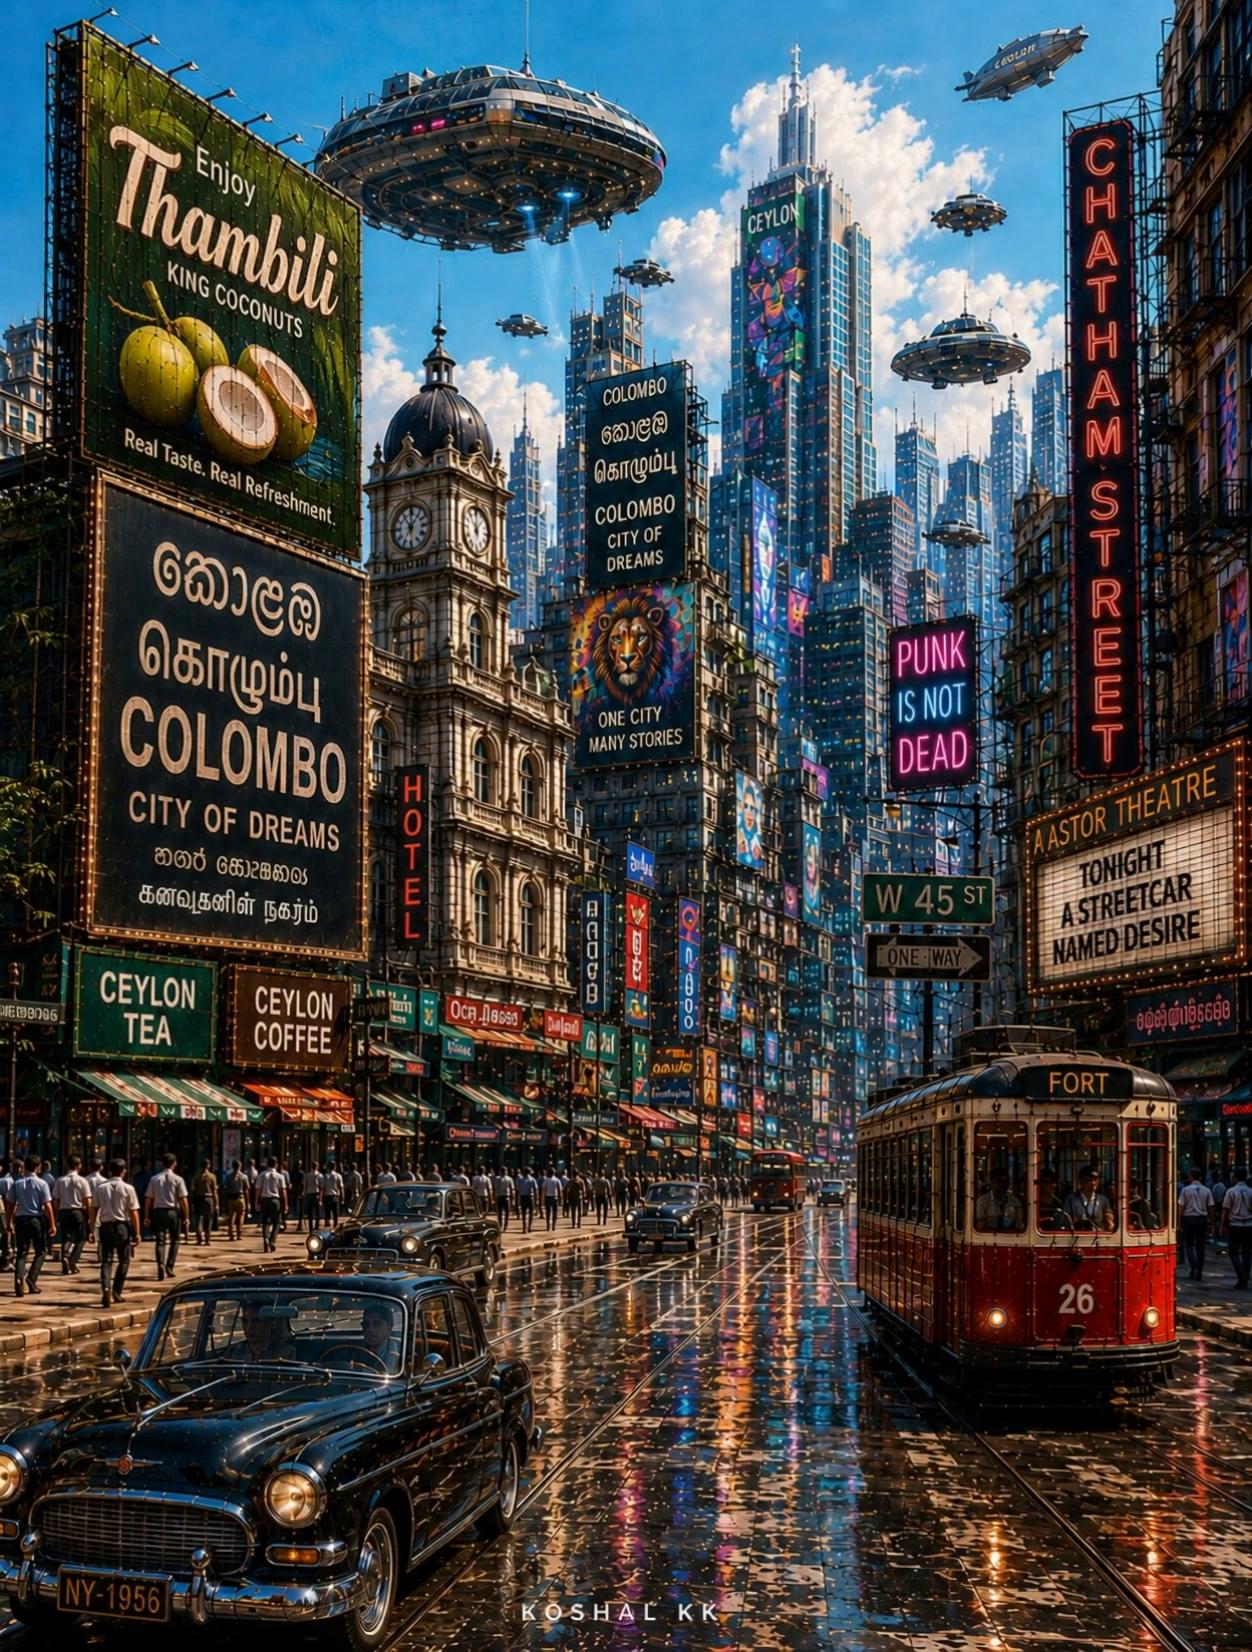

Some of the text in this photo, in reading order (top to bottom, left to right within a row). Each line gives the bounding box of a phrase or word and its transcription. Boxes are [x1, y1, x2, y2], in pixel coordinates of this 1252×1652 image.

[196, 147, 256, 207] Enjoy
[109, 125, 340, 316] Thambili
[748, 201, 799, 234] CEYLON
[168, 262, 304, 339] KING COCONUTS
[603, 377, 667, 407] COLOMBO
[1085, 138, 1123, 763] CHATHAM STREET
[124, 428, 336, 527] Real Taste. Real Refreshment.
[595, 494, 676, 526] COLOMBO
[607, 526, 663, 549] CITY OF
[607, 550, 664, 572] DREAMS
[897, 630, 966, 678] PUNK
[598, 706, 662, 728] ONE CITY
[898, 682, 966, 723] IS NOT
[120, 696, 347, 804] COLOMBO
[589, 728, 683, 753] MANY STORIES
[899, 731, 968, 774] DEAD
[128, 791, 340, 852] CITY OF DREAMS
[1047, 806, 1106, 850] ASTOR
[1115, 765, 1217, 826] THEATRE
[404, 774, 421, 939] HOTEL
[1079, 839, 1166, 888] TONIGHT
[875, 884, 987, 915] W 45 ST
[1061, 872, 1192, 928] A STREETCAR
[887, 948, 962, 967] ONE WAY
[1053, 910, 1201, 966] NAMED DESIRE
[100, 971, 196, 1010] CEYLON
[255, 986, 333, 1021] CEYLON
[123, 1012, 172, 1046] TEA
[254, 1022, 332, 1054] COFFEE
[1048, 1071, 1110, 1095] FORT
[1058, 1283, 1095, 1315] 26
[64, 1578, 161, 1615] NY-1956
